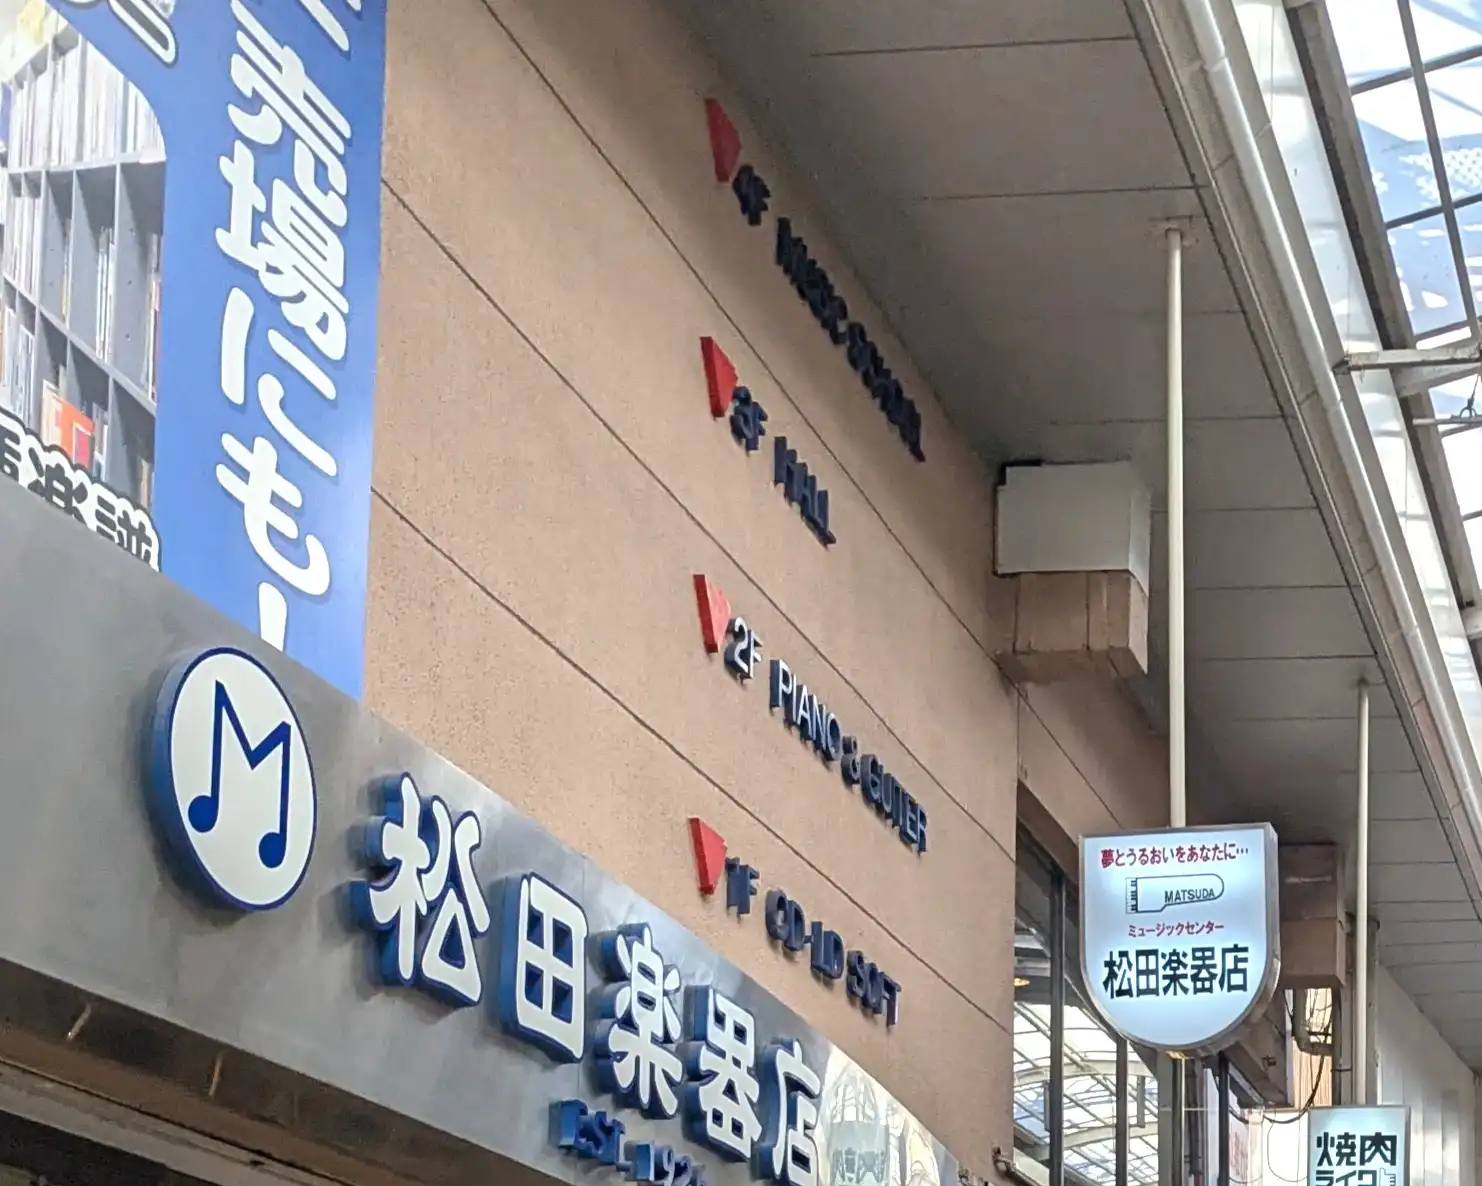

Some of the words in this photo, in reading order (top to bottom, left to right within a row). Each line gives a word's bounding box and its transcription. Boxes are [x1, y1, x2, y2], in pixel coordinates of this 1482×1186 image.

[724, 616, 764, 680] 2F
[769, 659, 842, 763] PIANO
[1164, 887, 1216, 904] MATSUDA
[1128, 920, 1225, 938] ミュージックセンター
[1102, 943, 1250, 1000] 松田楽器店
[1316, 1131, 1398, 1167] 焼肉
